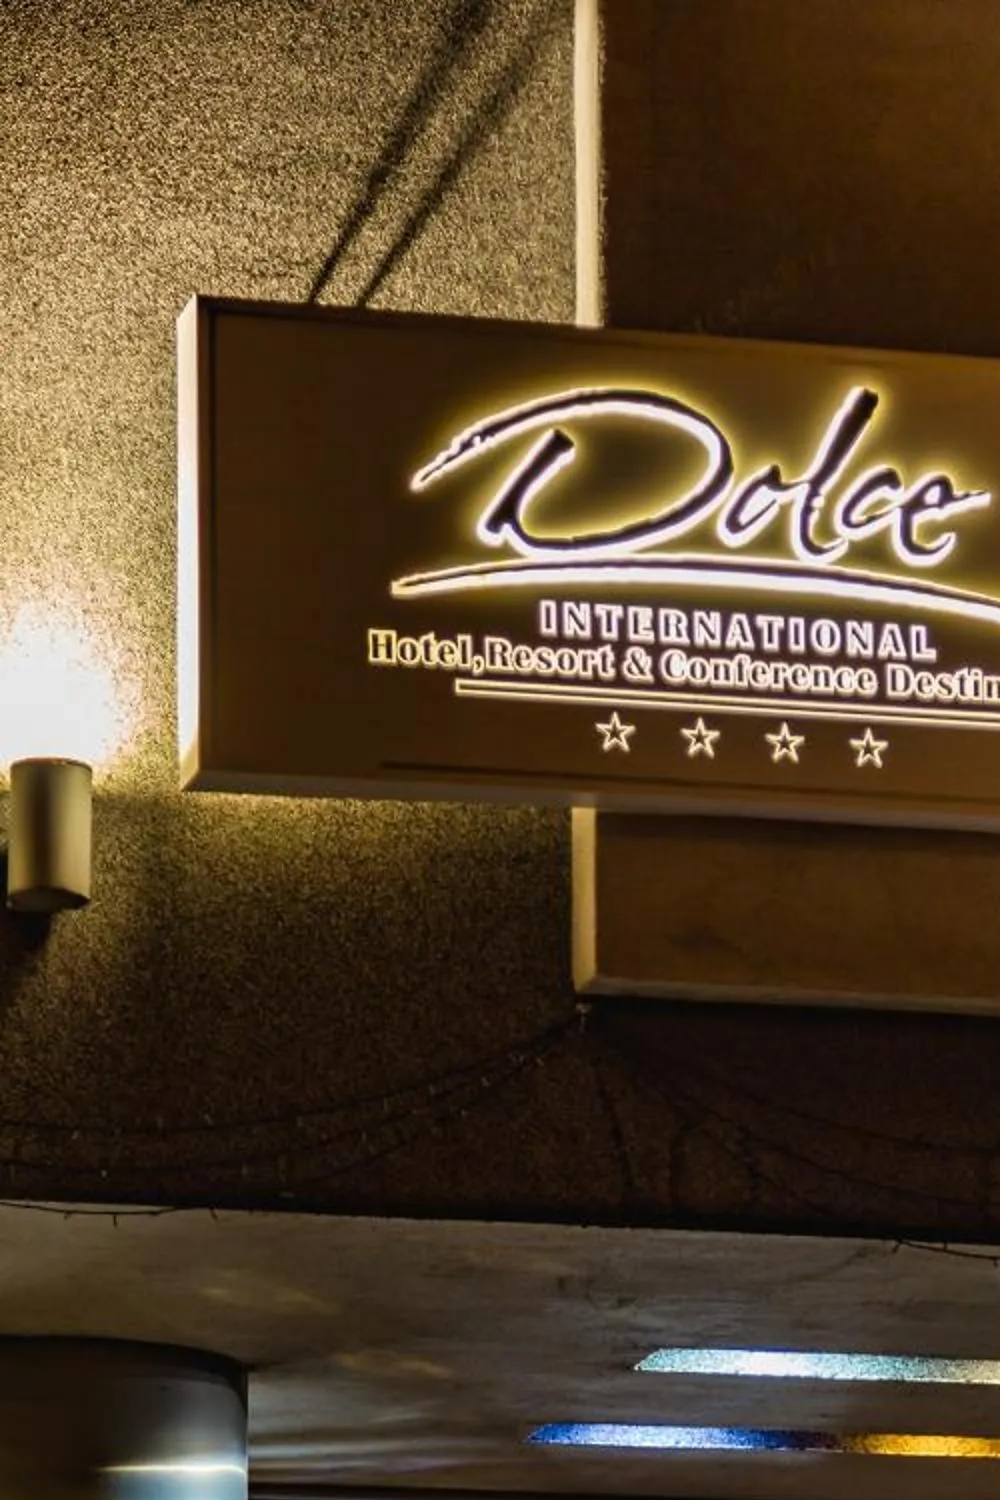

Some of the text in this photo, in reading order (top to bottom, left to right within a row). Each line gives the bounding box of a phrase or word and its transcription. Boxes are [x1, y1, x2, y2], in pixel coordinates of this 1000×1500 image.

[410, 386, 992, 566] Dolce
[538, 599, 937, 662] INTERNATIONAL
[622, 648, 655, 684] &
[659, 650, 878, 696] Conference
